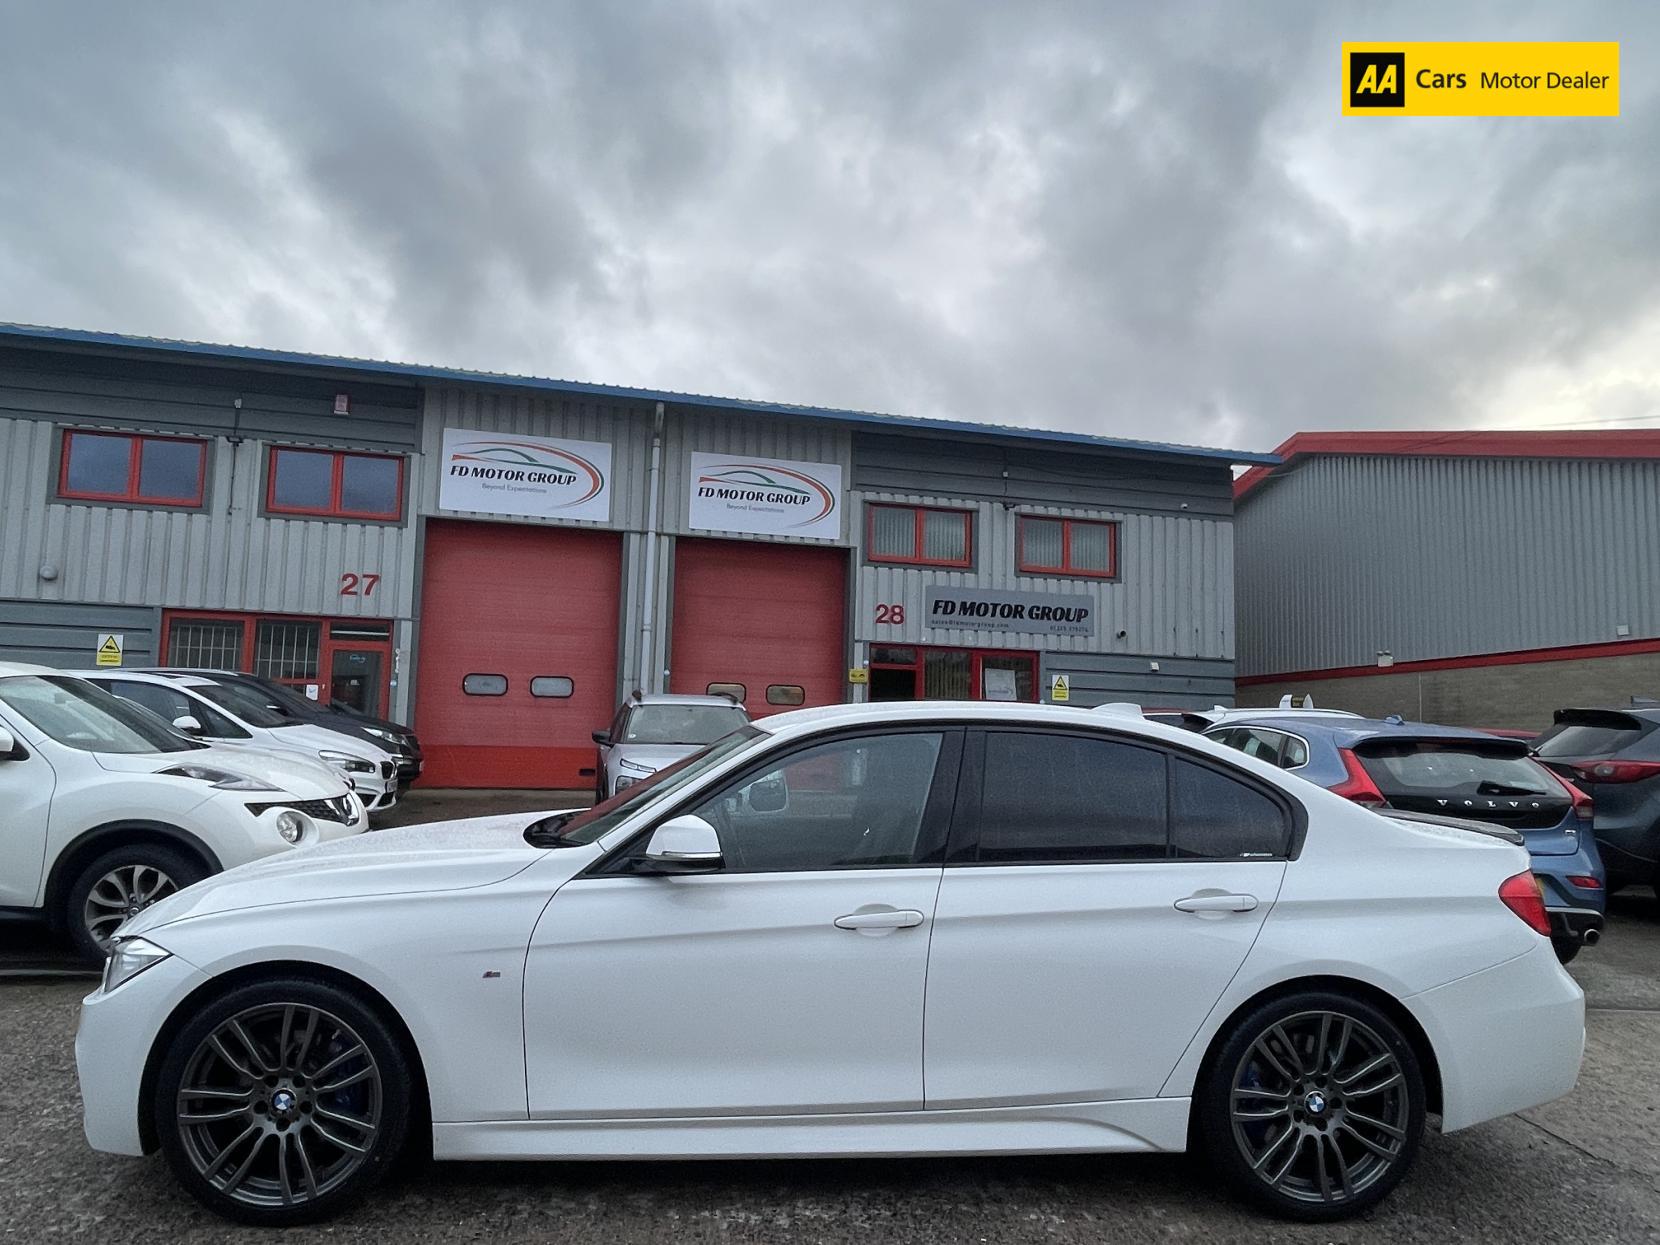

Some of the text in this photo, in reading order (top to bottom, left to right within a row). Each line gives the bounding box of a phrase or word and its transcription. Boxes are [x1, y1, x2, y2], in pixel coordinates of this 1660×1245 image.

[450, 465, 577, 486] FD MOTOR GROUP
[482, 483, 506, 492] Beyond
[698, 487, 811, 506] FD MOTOR GROUP
[340, 572, 380, 596] 27
[876, 604, 904, 625] 28
[932, 599, 1089, 623] FD MOTOR GROUP
[1437, 799, 1539, 808] VOLVO
